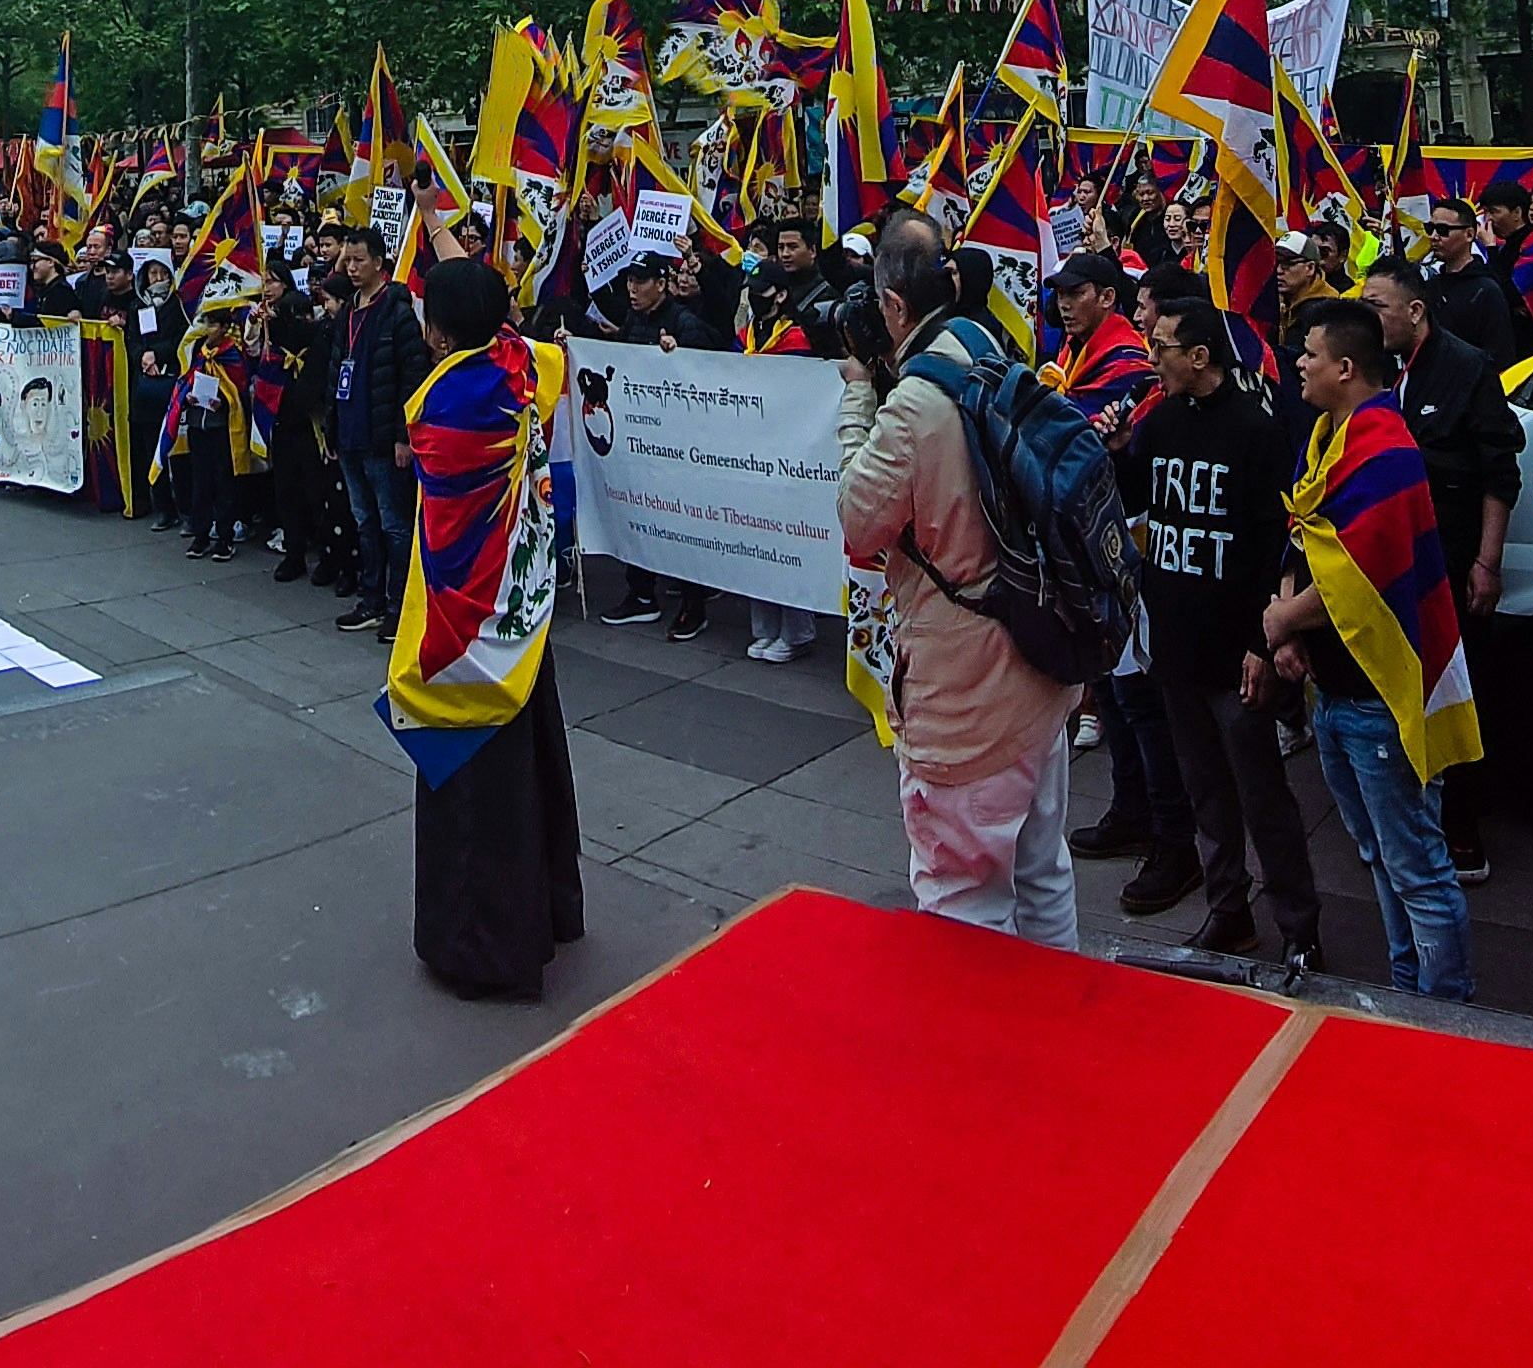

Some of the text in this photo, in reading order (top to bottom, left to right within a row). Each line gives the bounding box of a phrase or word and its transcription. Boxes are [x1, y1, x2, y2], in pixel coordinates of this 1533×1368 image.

[641, 207, 666, 225] DERGÉ
[668, 214, 682, 226] ET
[591, 232, 615, 259] DERGÉ
[616, 226, 626, 241] ET
[627, 437, 841, 482] Tibetaanse Gemeenschap Nederlan
[1153, 457, 1229, 515] FREE
[645, 492, 680, 514] behoud
[684, 503, 702, 519] van
[704, 504, 718, 521] de
[721, 507, 782, 533] Tibetaanse
[786, 521, 830, 540] cultuur
[1149, 520, 1233, 580] TIBET
